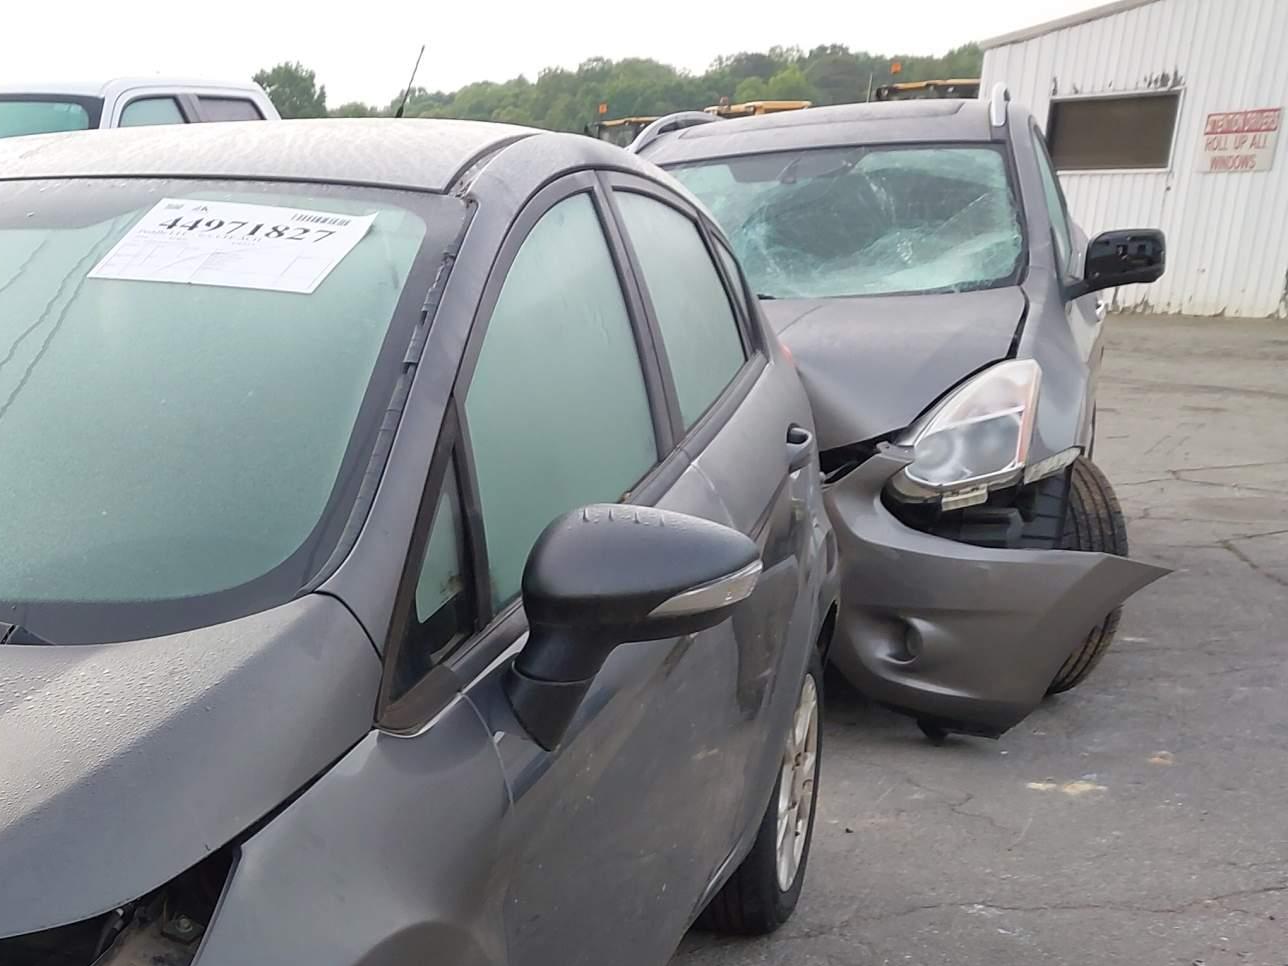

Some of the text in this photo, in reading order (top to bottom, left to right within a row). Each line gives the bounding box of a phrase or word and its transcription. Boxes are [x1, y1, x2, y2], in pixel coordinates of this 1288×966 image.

[1205, 134, 1267, 152] ROLL UP ALL
[1210, 155, 1256, 170] WINDOWS
[159, 215, 337, 242] 44971827
